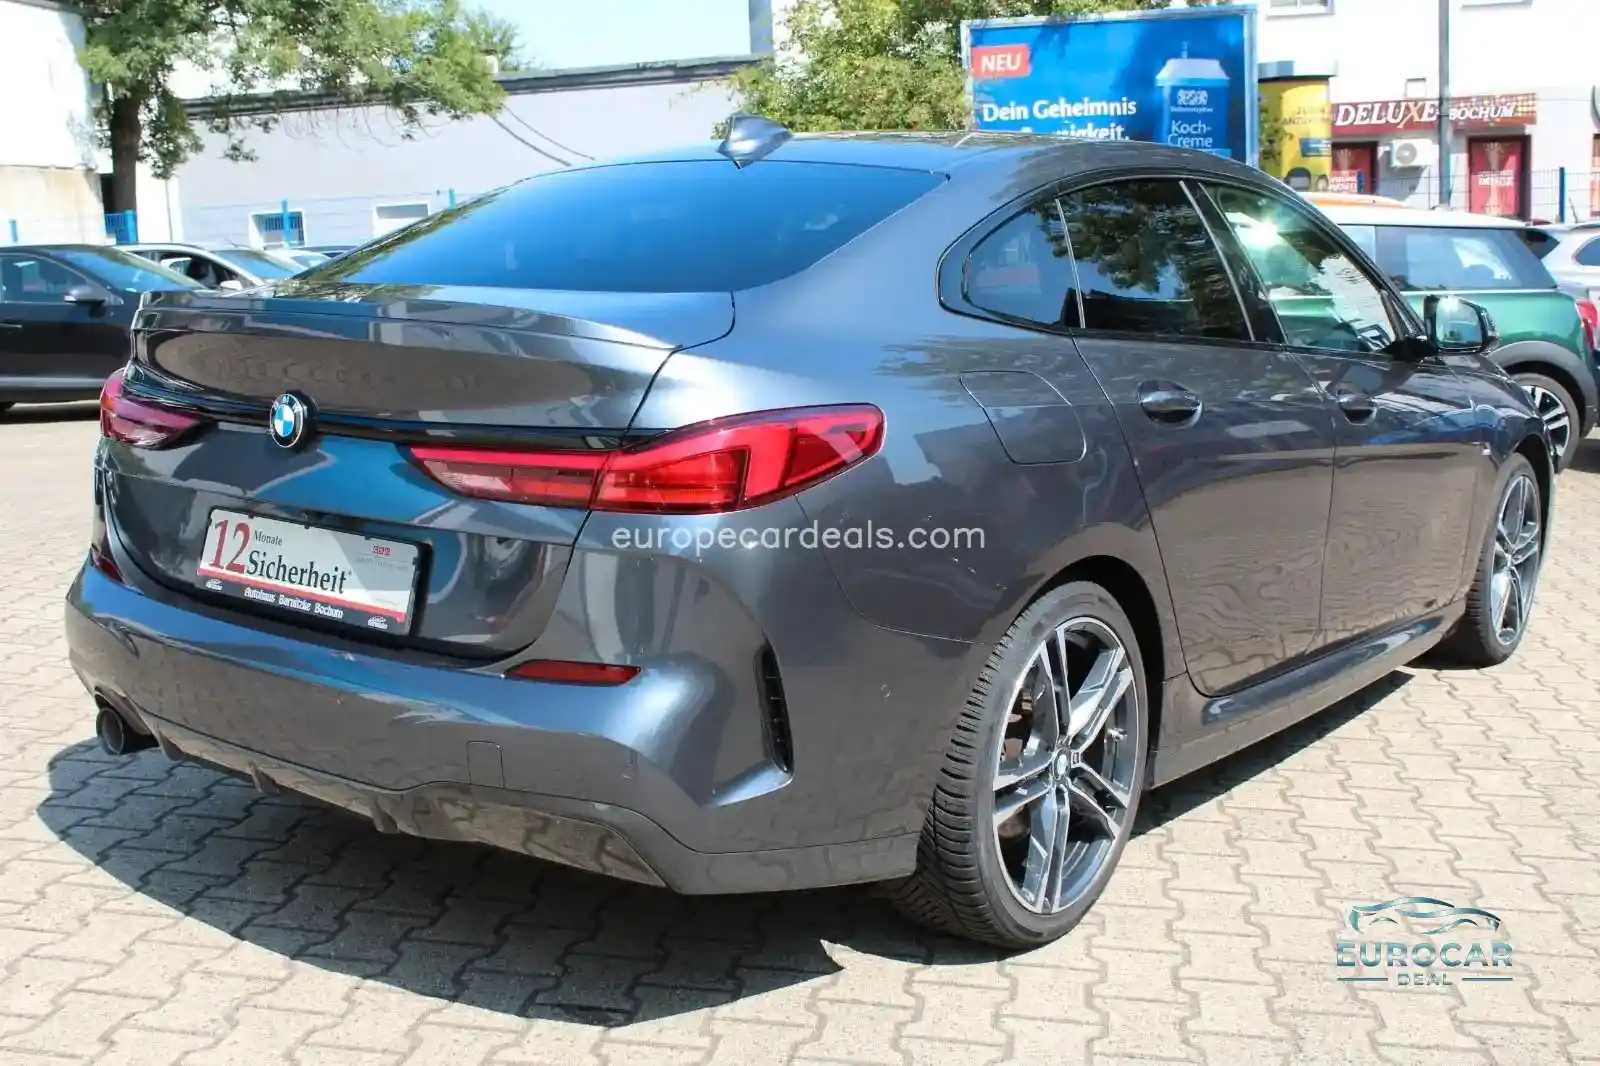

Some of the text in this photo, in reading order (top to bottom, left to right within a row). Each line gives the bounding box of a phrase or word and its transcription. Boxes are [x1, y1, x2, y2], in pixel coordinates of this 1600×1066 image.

[980, 53, 1021, 73] NEU
[983, 97, 1137, 122] Dein Geheimnis
[1334, 100, 1438, 128] DELUXE
[1449, 103, 1516, 121] BOCHUM
[1171, 119, 1212, 134] Koch-
[1167, 133, 1213, 148] Creme
[209, 519, 283, 574] 12 Monate
[246, 550, 348, 594] Sicherheit
[244, 586, 276, 604] Autohaus
[314, 602, 344, 620] Bochum
